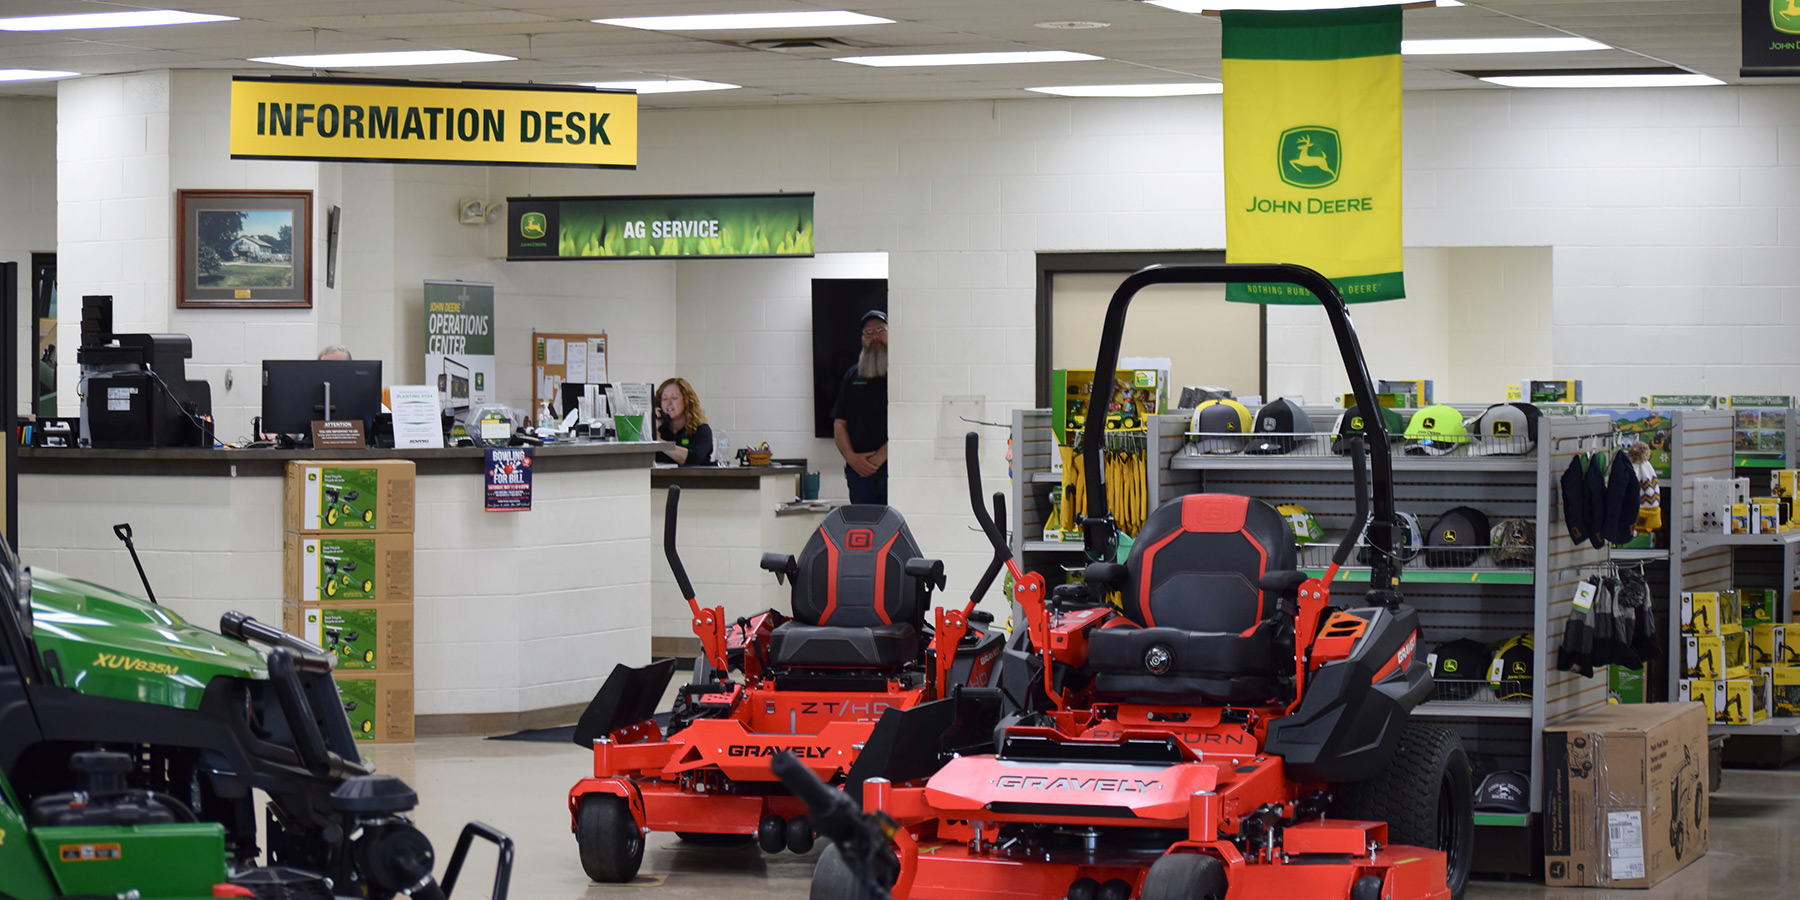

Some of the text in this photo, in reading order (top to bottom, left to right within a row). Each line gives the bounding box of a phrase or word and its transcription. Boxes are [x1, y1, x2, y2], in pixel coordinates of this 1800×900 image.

[1769, 41, 1795, 50] JOHN
[257, 102, 612, 146] INFORMATION DESK
[1246, 196, 1373, 214] JOHN DEERE
[623, 220, 719, 239] AG SERVICE
[1247, 284, 1283, 295] NOTHING
[1287, 287, 1311, 297] RUNS
[1348, 283, 1377, 294] DEERE
[429, 302, 461, 313] JOHN DEERE
[429, 313, 488, 335] OPERATIONS
[429, 335, 466, 355] CENTER
[492, 450, 525, 462] BOWLING
[493, 472, 524, 484] FOR BILL
[92, 652, 179, 675] XUV835M
[996, 775, 1159, 793] GRAVELY
